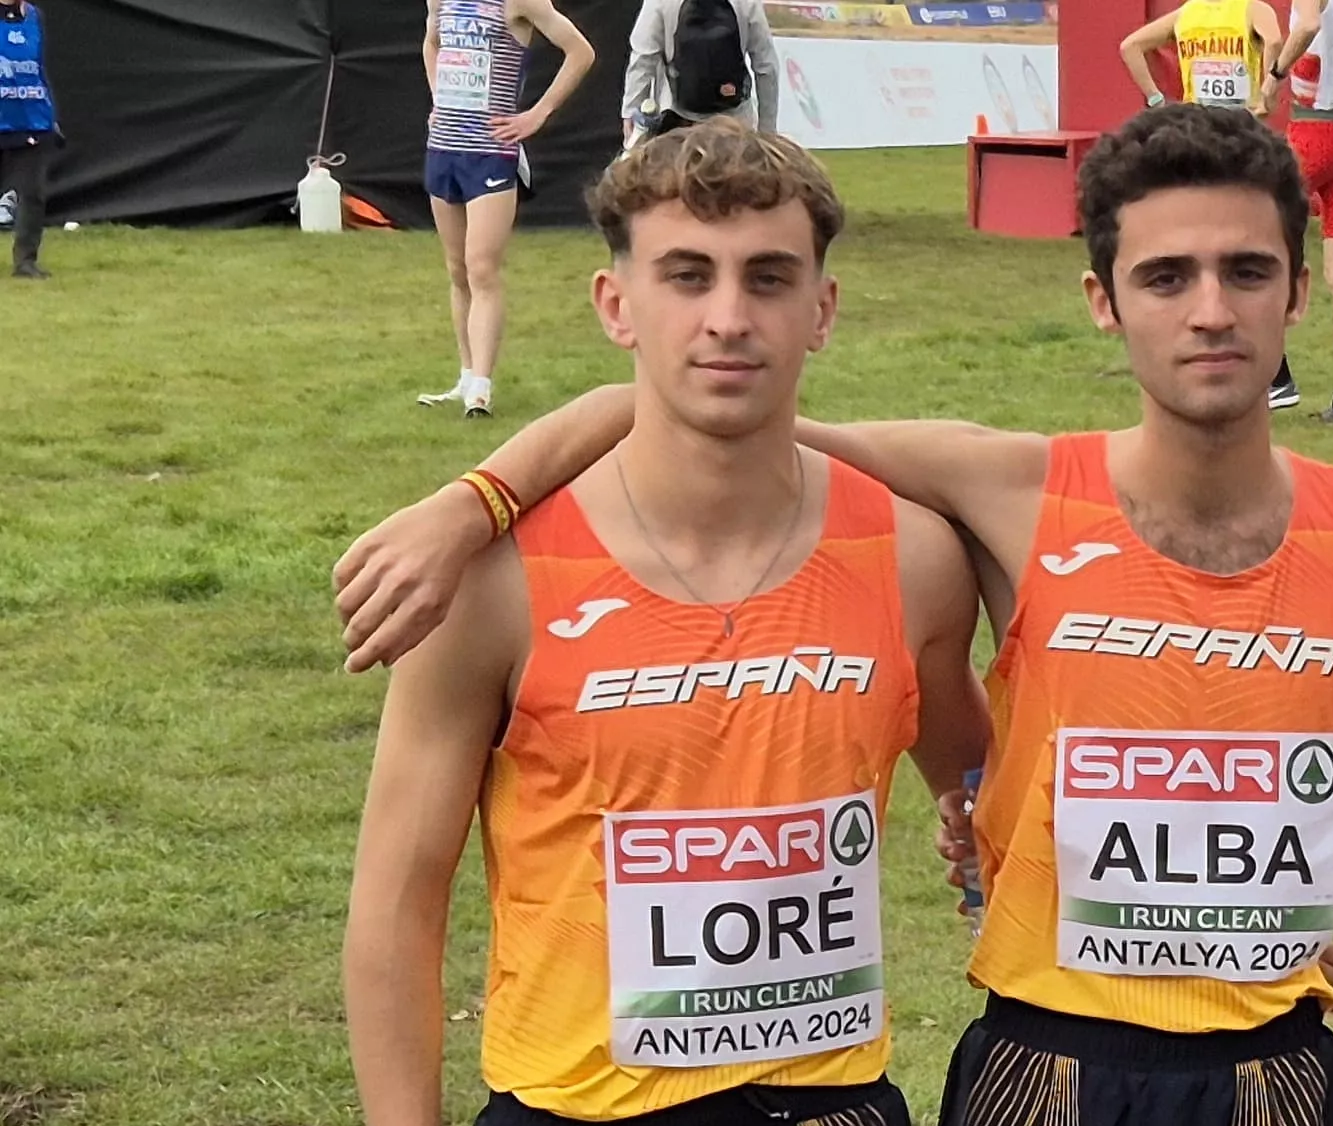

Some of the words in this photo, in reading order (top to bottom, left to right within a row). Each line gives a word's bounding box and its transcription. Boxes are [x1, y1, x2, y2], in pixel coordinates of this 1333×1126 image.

[1201, 79, 1235, 97] 468
[575, 647, 877, 713] ESPAÑA
[1070, 745, 1274, 793] SPAR
[619, 822, 820, 875] SPAR
[1089, 821, 1314, 886] ALBA
[650, 877, 856, 968] LORÉ
[1120, 907, 1126, 926] I
[1132, 908, 1191, 929] RUN
[1077, 935, 1241, 970] ANTALYA
[680, 995, 687, 1014] I
[693, 989, 751, 1013] RUN
[632, 1019, 799, 1057] ANTALYA
[807, 1003, 873, 1043] 2024
